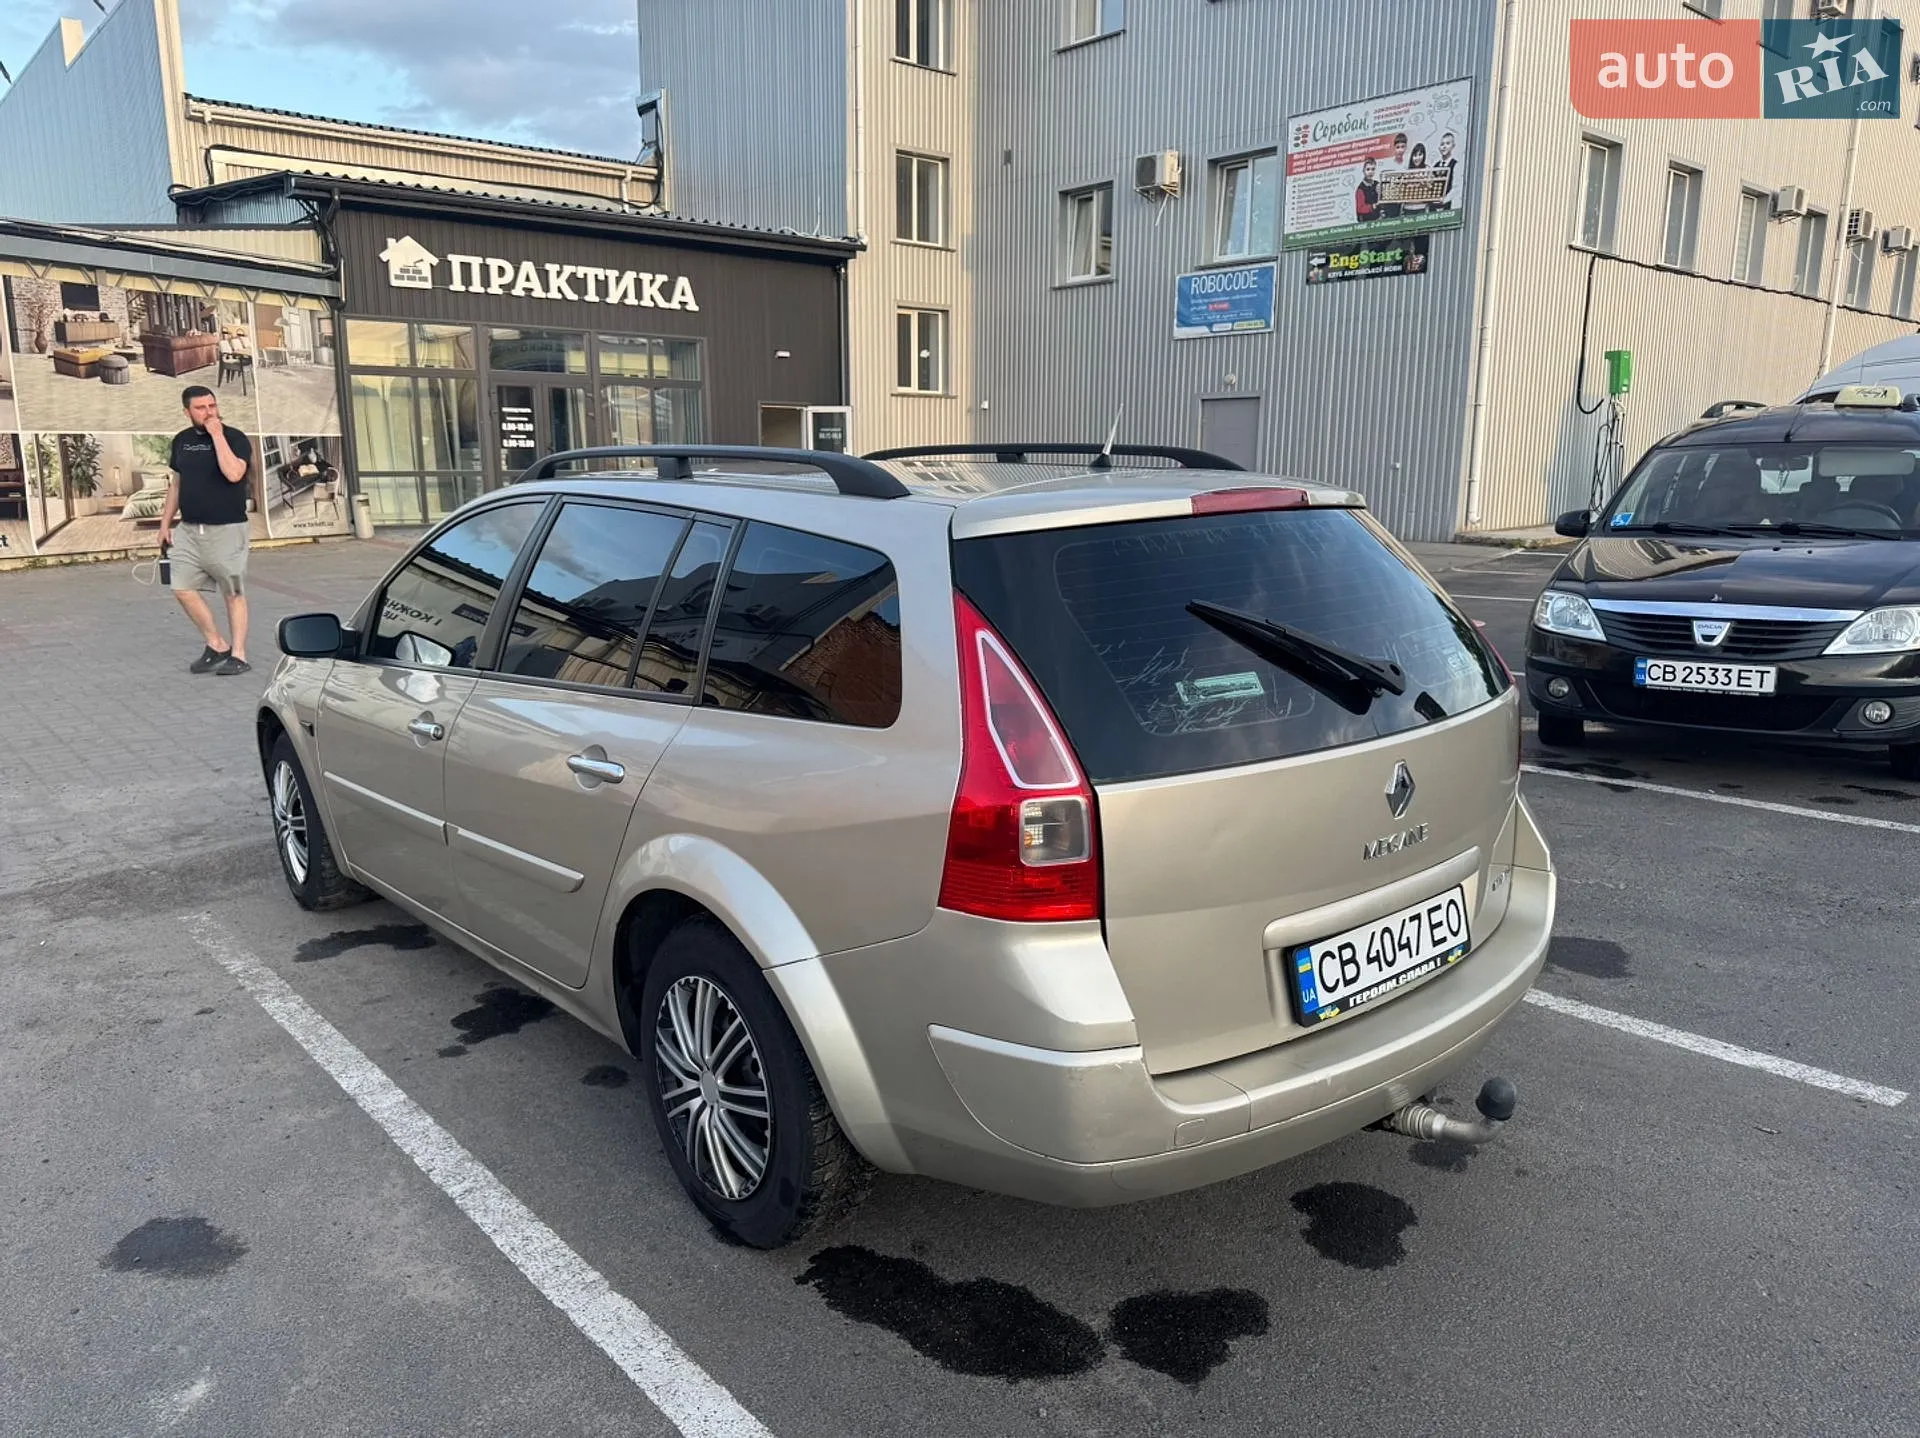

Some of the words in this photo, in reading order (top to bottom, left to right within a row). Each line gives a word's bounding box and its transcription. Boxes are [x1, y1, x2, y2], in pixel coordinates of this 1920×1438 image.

[1329, 248, 1404, 269] EngStart
[447, 253, 700, 312] ПРАКТИКА
[1190, 269, 1259, 295] ROBOCODE
[1681, 665, 1733, 688] 2533
[1318, 941, 1361, 993] CB
[1366, 912, 1422, 973] 4047
[1302, 987, 1317, 1004] UA
